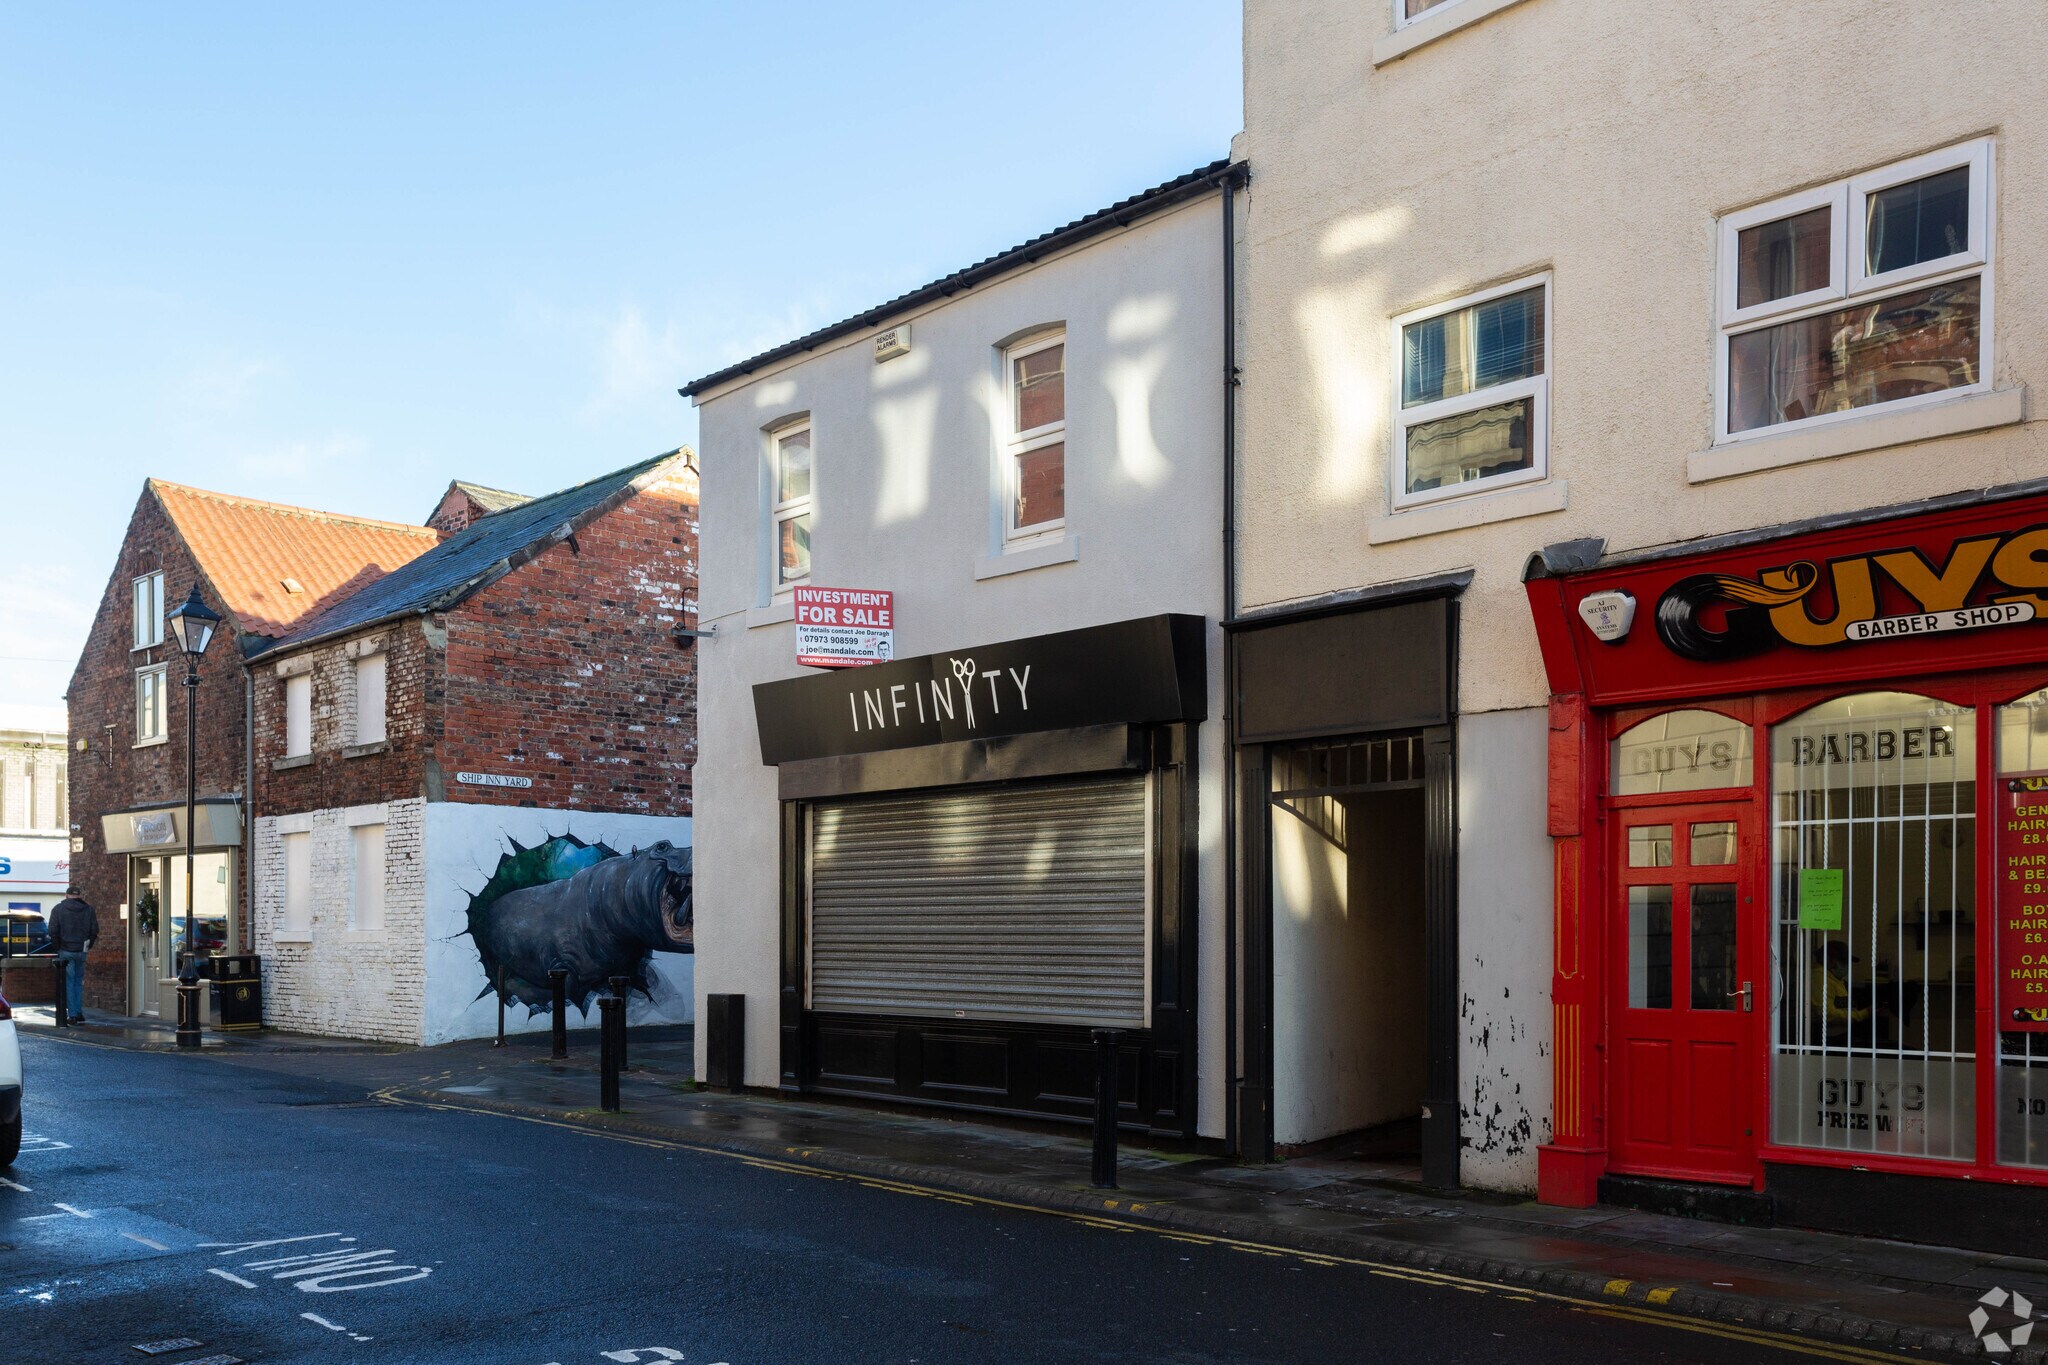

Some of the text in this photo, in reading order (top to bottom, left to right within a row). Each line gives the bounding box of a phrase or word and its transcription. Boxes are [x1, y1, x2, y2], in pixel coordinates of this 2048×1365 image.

[876, 332, 896, 344] RENDER
[877, 339, 897, 351] ALARMS
[797, 589, 890, 607] INVESTMENT
[798, 605, 890, 626] FOR SALE
[1587, 605, 1618, 614] SECURITY
[1857, 605, 2020, 638] BARBER SHOP
[866, 629, 890, 638] Darragh
[804, 635, 829, 644] 07973
[830, 636, 859, 645] 908599
[805, 645, 874, 656] joe@mandale.com
[800, 657, 874, 666] www.mandale.com
[1791, 726, 1955, 768] BARBER
[1632, 740, 1736, 776] GUYS
[461, 773, 528, 787] SHIP INN YARD
[2008, 819, 2048, 831] HAIR
[2023, 834, 2048, 845] £8.
[2008, 855, 2046, 867] HAIR
[2008, 869, 2048, 881] & BE
[2023, 883, 2048, 894] £9.
[2023, 905, 2048, 915] BO
[2017, 1097, 2046, 1116] NO
[1817, 1110, 1869, 1130] FREE
